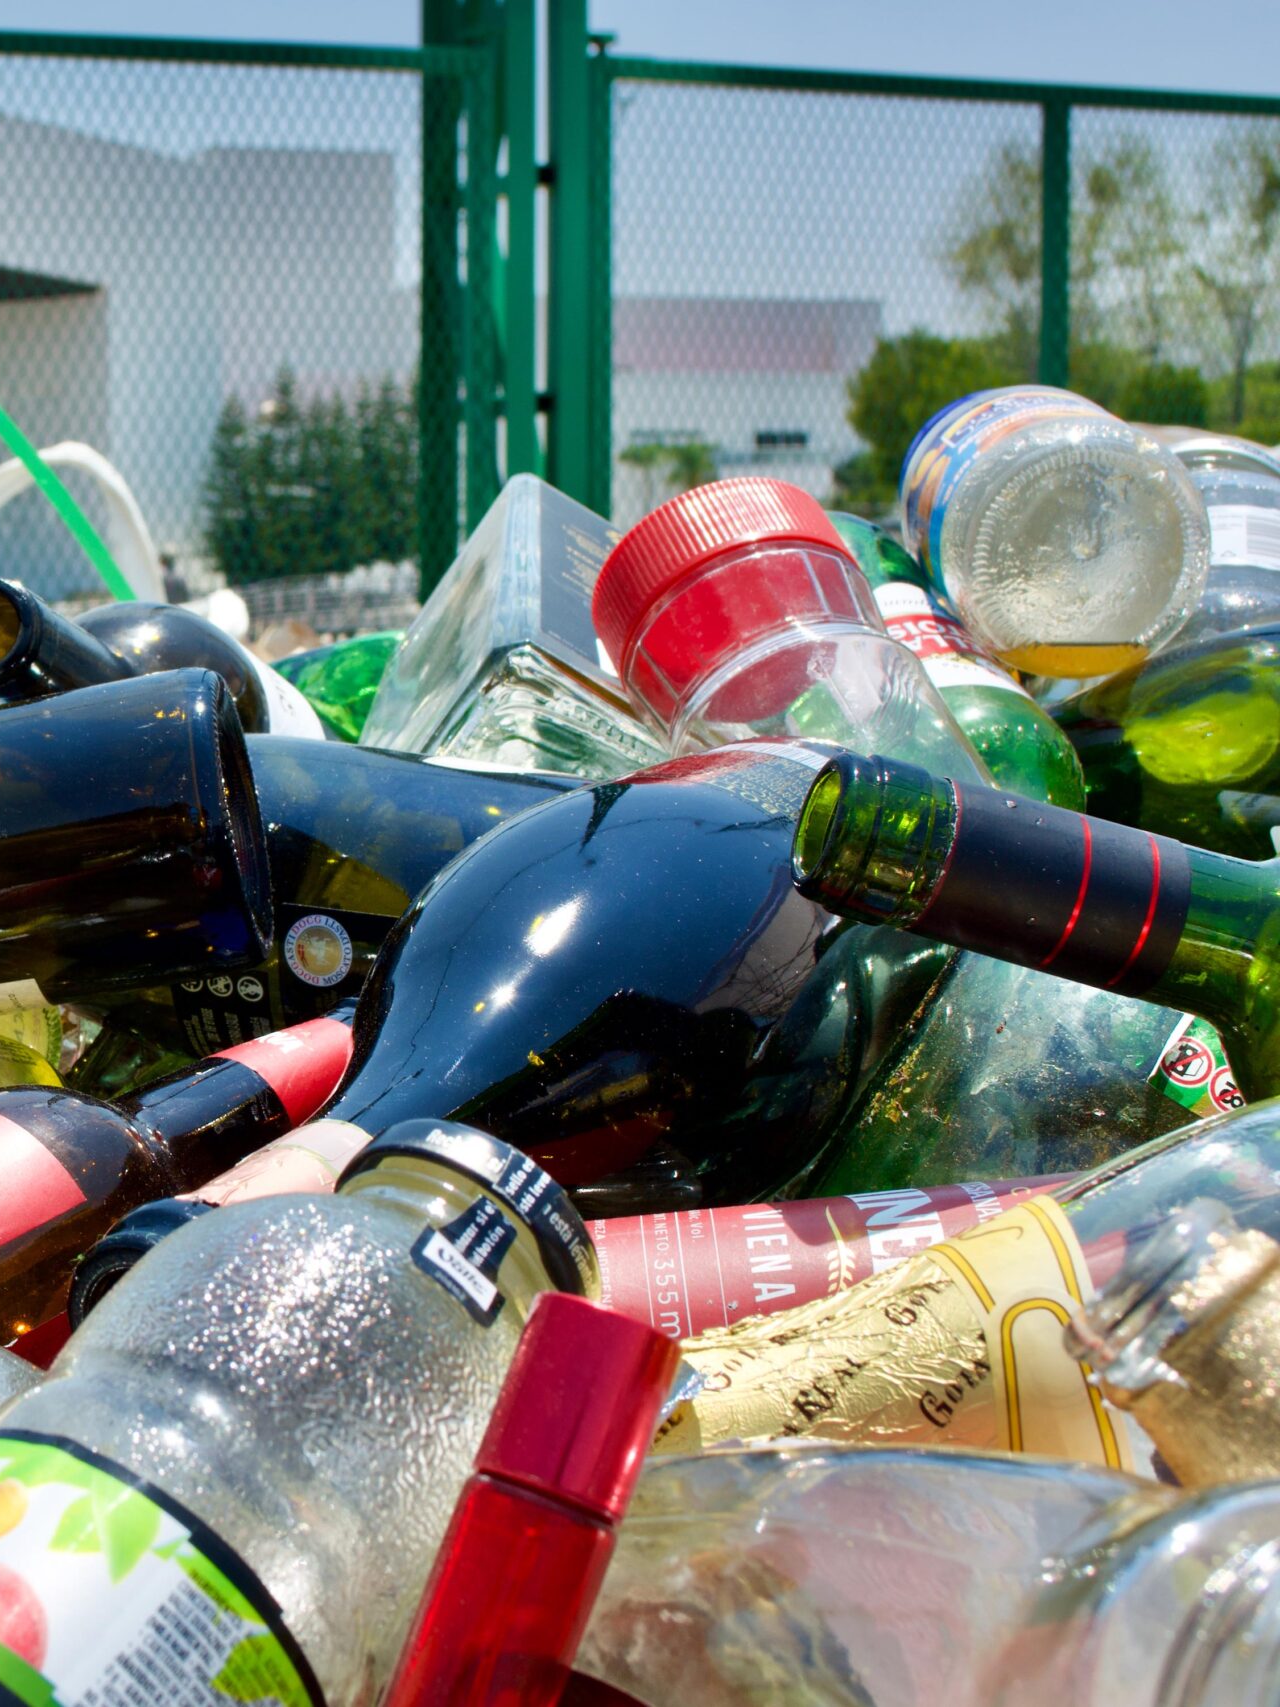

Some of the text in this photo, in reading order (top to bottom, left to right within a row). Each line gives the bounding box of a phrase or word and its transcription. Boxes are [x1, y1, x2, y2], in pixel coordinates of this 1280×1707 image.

[285, 933, 296, 961] ASTI
[322, 946, 351, 984] MOSCATO
[690, 1223, 705, 1243] Vol.
[741, 1208, 796, 1303] VIENA
[653, 1256, 680, 1307] 355
